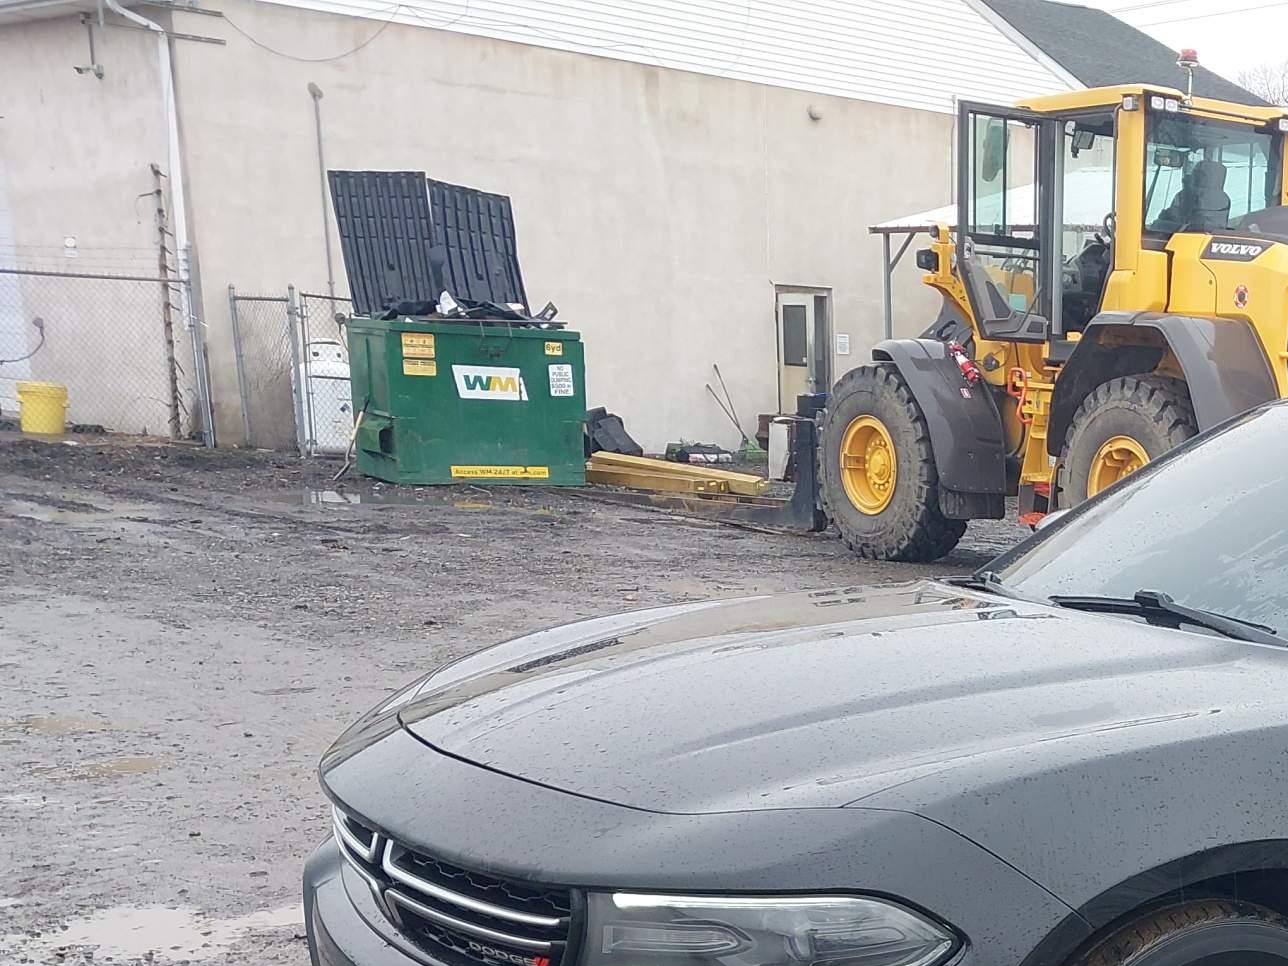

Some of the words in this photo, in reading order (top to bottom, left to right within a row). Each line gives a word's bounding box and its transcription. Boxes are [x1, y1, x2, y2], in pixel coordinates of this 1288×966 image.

[1211, 243, 1262, 256] VOLVO
[546, 343, 561, 353] 6yd
[463, 375, 518, 393] WM
